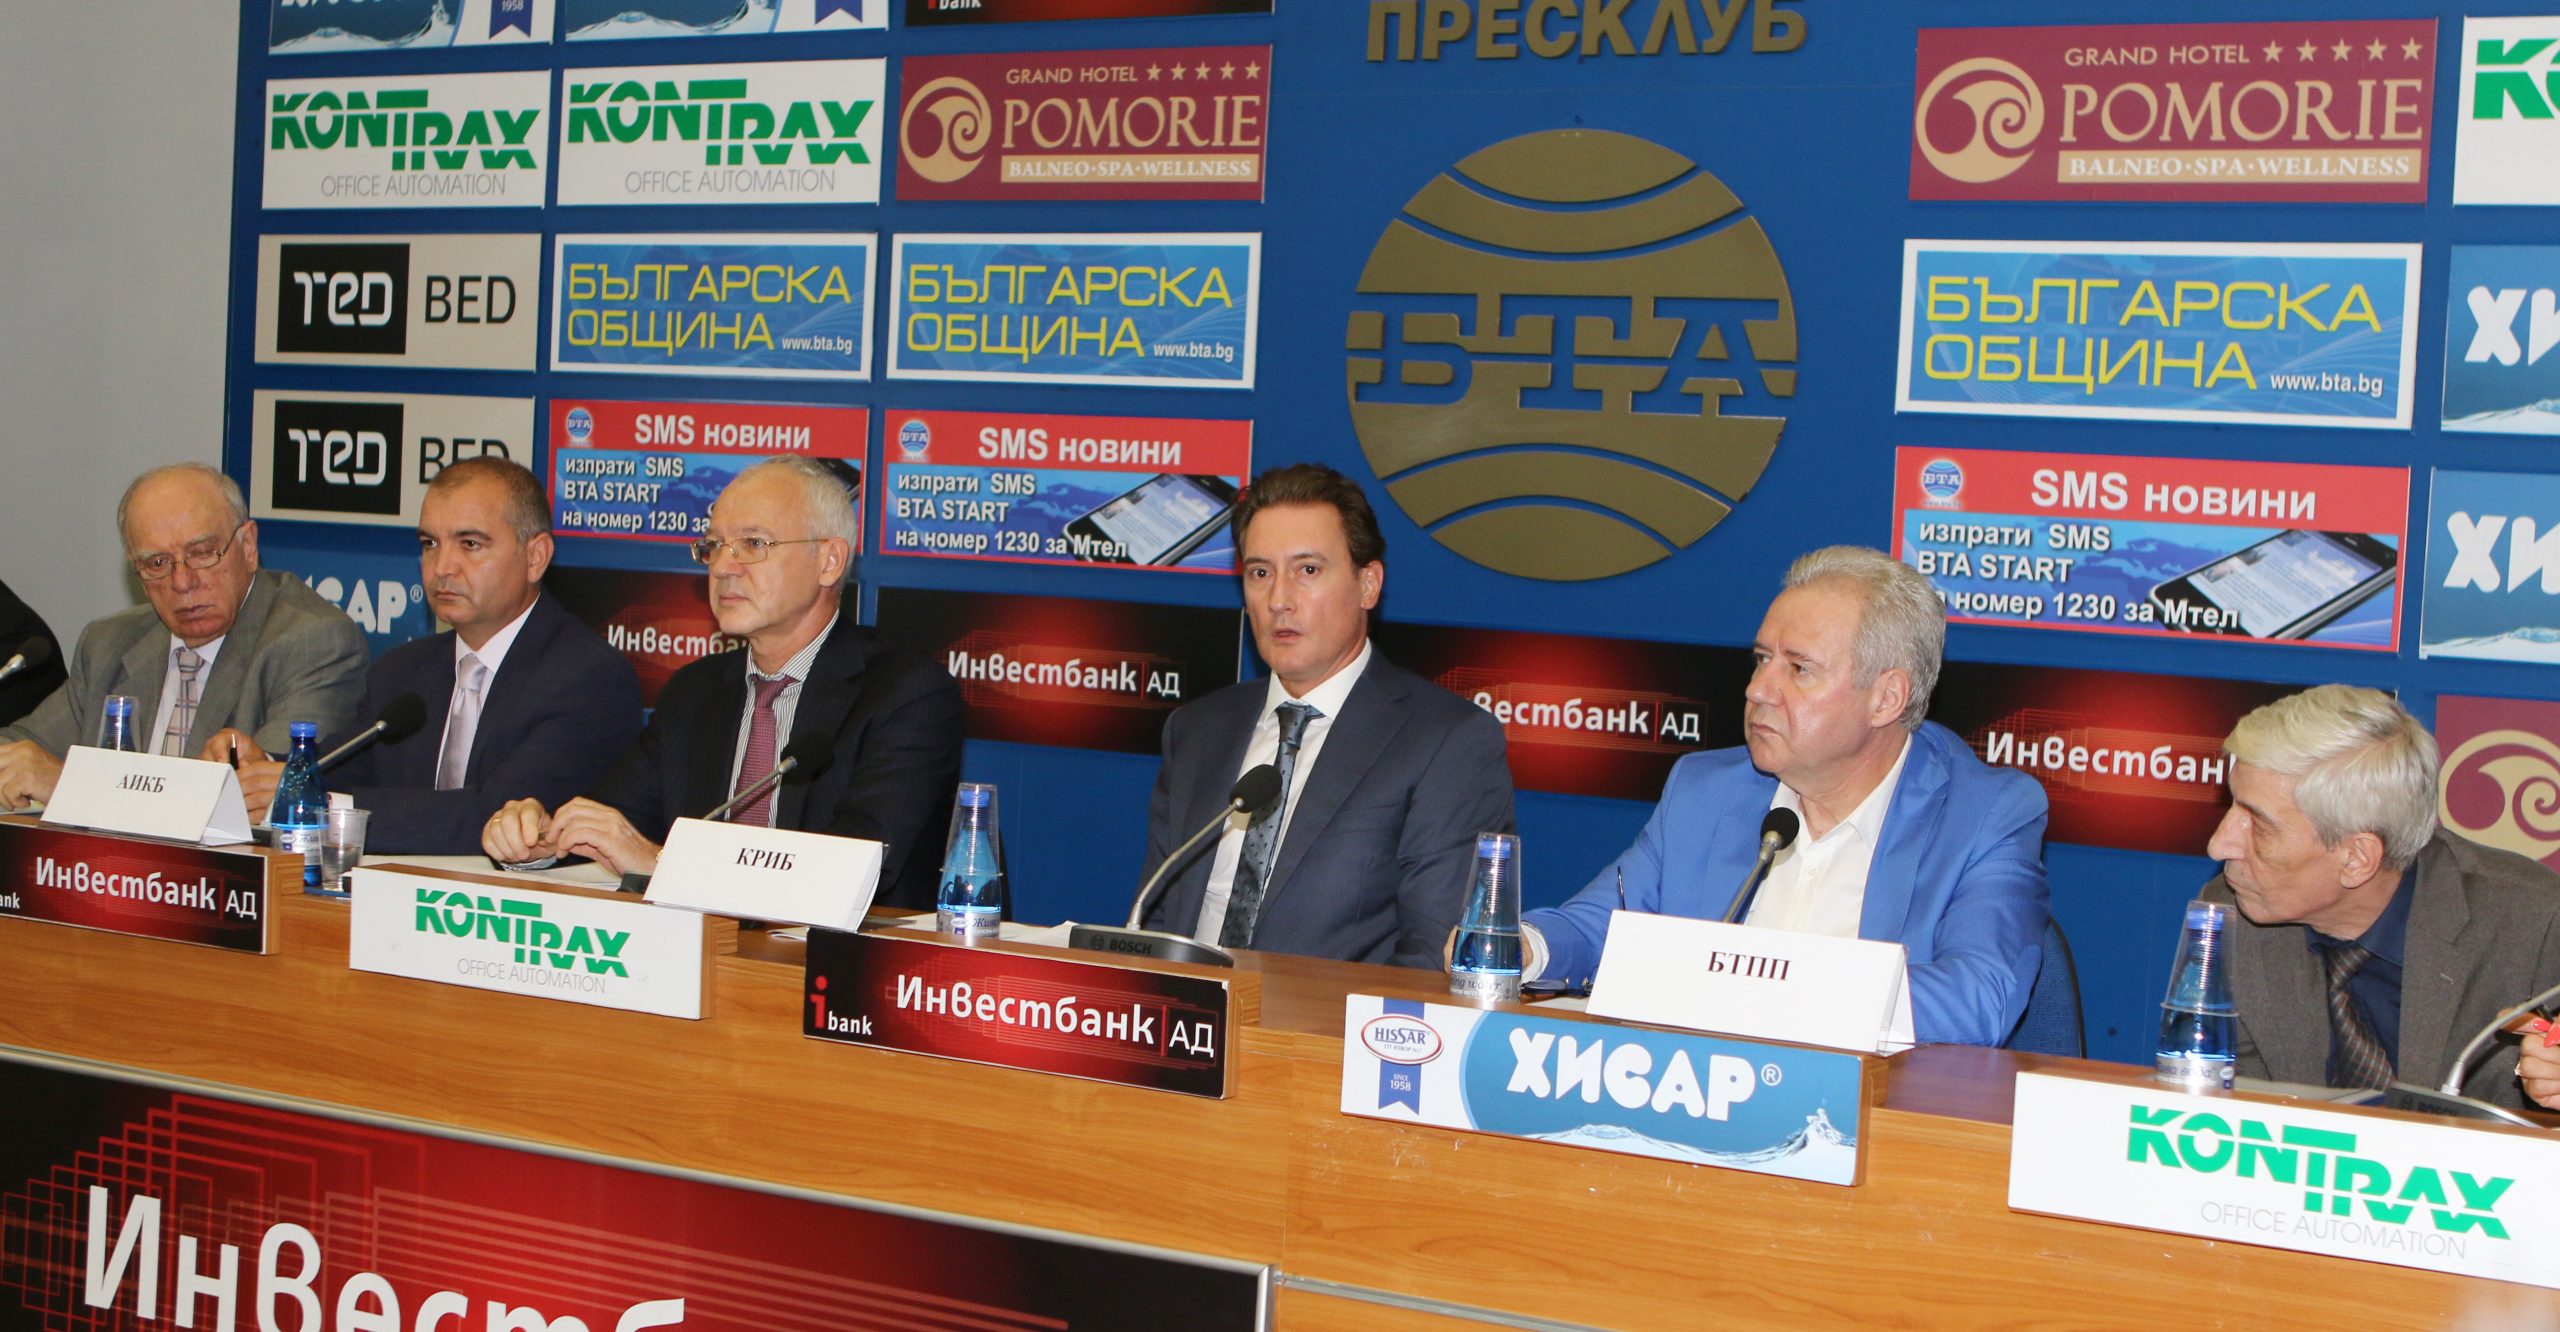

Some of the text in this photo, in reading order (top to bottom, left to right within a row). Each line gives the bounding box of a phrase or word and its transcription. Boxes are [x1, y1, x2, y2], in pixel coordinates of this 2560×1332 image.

[1365, 0, 1808, 62] ПРЕСКЛУБ
[2064, 44, 2250, 67] GRAND HOTEL
[1006, 66, 1138, 84] GRAND HOTEL
[567, 78, 875, 166] KONTRAX
[1002, 95, 1261, 148] POMORIE
[2059, 79, 2423, 142] POMORIE
[271, 89, 541, 171] KONTRAX
[321, 173, 506, 197] OFFICE AUTOMATION
[625, 169, 835, 194] OFFICE AUTOMATION
[294, 271, 516, 327] TED BED
[568, 263, 851, 304] БЪЛГАРСКА
[908, 264, 1233, 308] БЪЛГАРСКА
[1926, 275, 2383, 333] БЪЛГАРСКА
[567, 310, 774, 357] ОБЩИНА
[781, 334, 853, 356] www.bta.bg
[906, 313, 1145, 364] ОБЩИНА
[1153, 341, 1234, 363] www.bta.bg
[1353, 293, 1788, 418] БТА
[1924, 333, 2258, 395] ОБЩИНА
[2269, 373, 2384, 398] www.bta.bg
[635, 414, 811, 450] SMS новини
[978, 427, 1182, 466] SMS новини
[288, 428, 387, 486] TED
[565, 457, 684, 479] изпрати SMS
[564, 480, 661, 503] BTA START
[898, 473, 1036, 496] изпрати SMS
[2031, 469, 2316, 521] SMS новини
[562, 511, 710, 533] на номер 1230 за
[897, 498, 1009, 523] BTA START
[895, 530, 1127, 558] на номер 1230 за Мтел
[1919, 523, 2112, 552] изпрати SMS
[1917, 550, 2073, 584] BTA START
[1954, 591, 2043, 622] номер
[2052, 593, 2116, 622] 1230
[2123, 602, 2155, 624] за
[2163, 600, 2239, 630] Мтел
[607, 624, 750, 656] Инвестба
[948, 650, 1181, 698] Инвестбанк АД
[1473, 692, 1700, 742] вестбанк АД
[117, 774, 166, 794] АИКБ
[735, 846, 796, 872] КРИБ
[36, 856, 257, 920] Инвестбанк АД
[415, 888, 631, 979] KONTRAX
[1109, 938, 1152, 955] BOSCH
[457, 958, 606, 994] OFFICE AUTOMATION
[1707, 950, 1792, 982] БТПП
[896, 974, 1215, 1058] Инвестбанк АД
[1374, 1027, 1427, 1045] HISSAR
[1390, 1079, 1412, 1091] 1958
[2127, 1104, 2515, 1240] KONTRAX
[2200, 1201, 2467, 1260] OFFICE AUTOMATION
